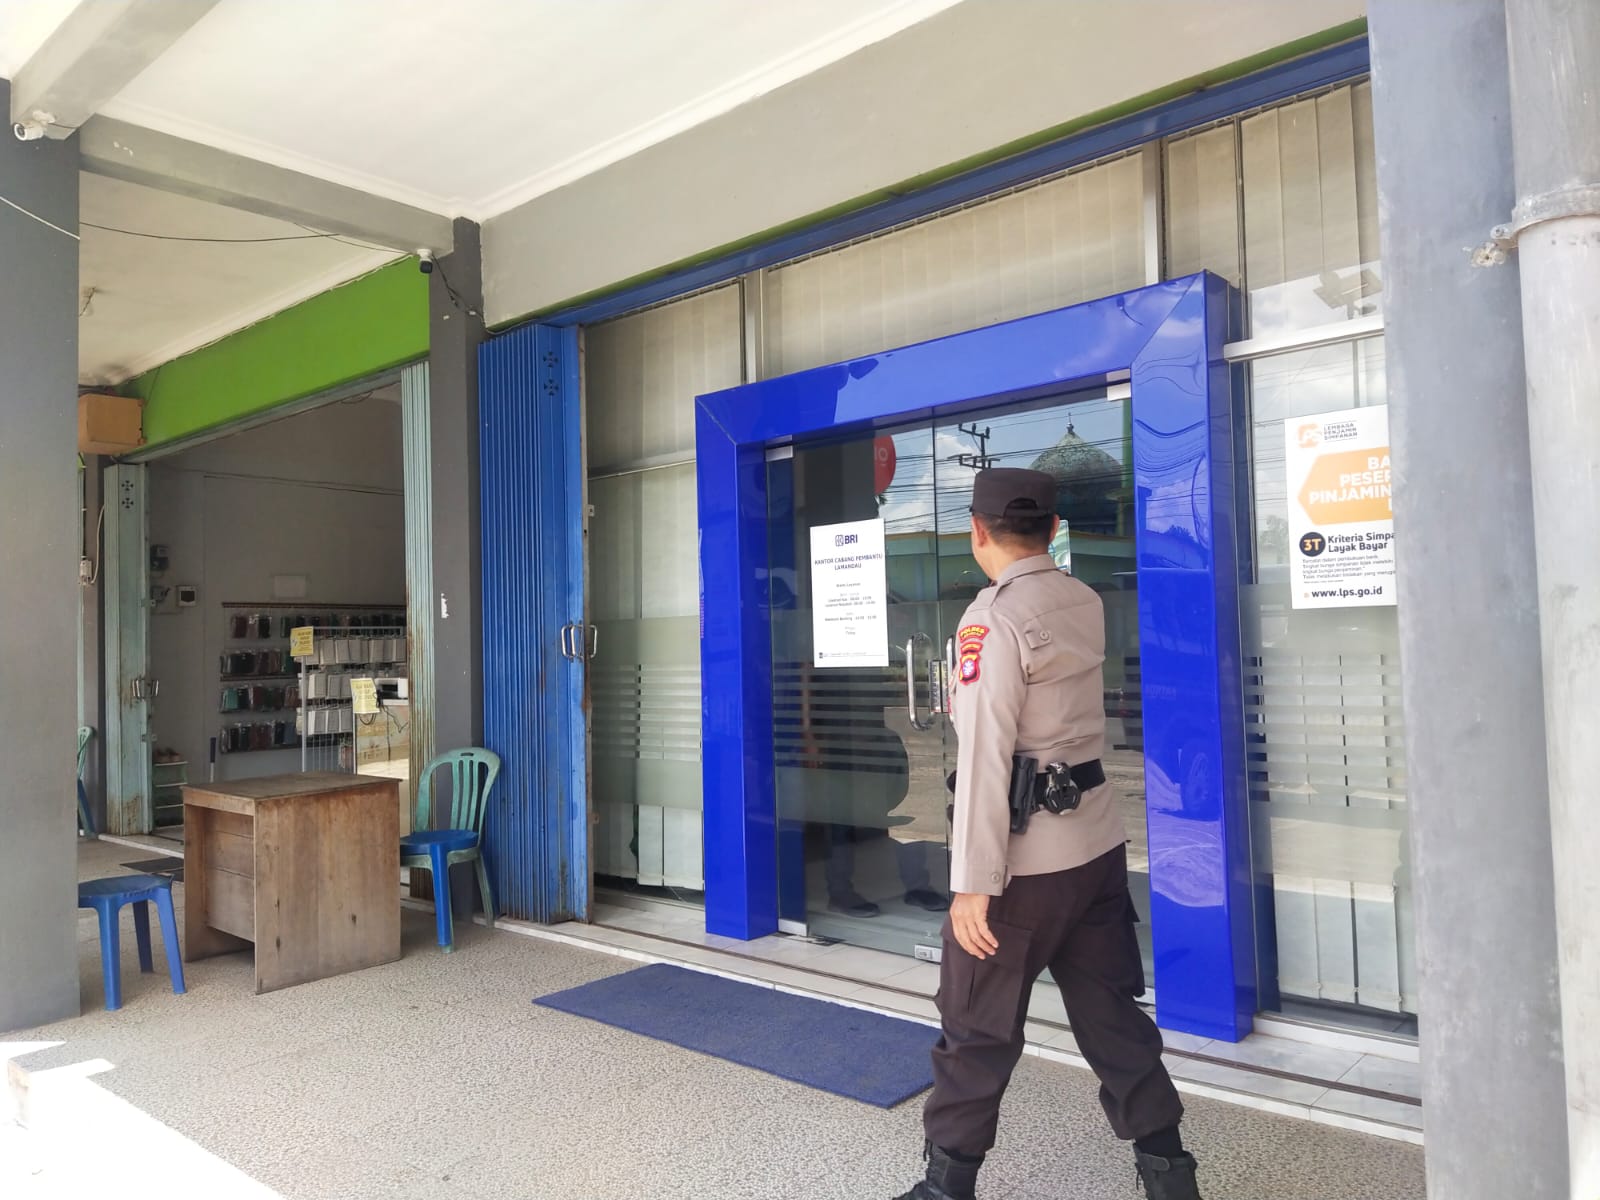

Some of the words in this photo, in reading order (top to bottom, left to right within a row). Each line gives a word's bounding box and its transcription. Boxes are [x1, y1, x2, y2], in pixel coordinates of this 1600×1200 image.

[844, 534, 858, 544] BRI
[1328, 533, 1364, 544] Kriteria
[1303, 538, 1322, 551] 3T
[1328, 542, 1357, 553] Layak
[1359, 541, 1388, 551] Bayar
[814, 557, 834, 565] KANTOR
[834, 555, 855, 563] CABANG
[1311, 585, 1383, 598] www.lps.go.id
